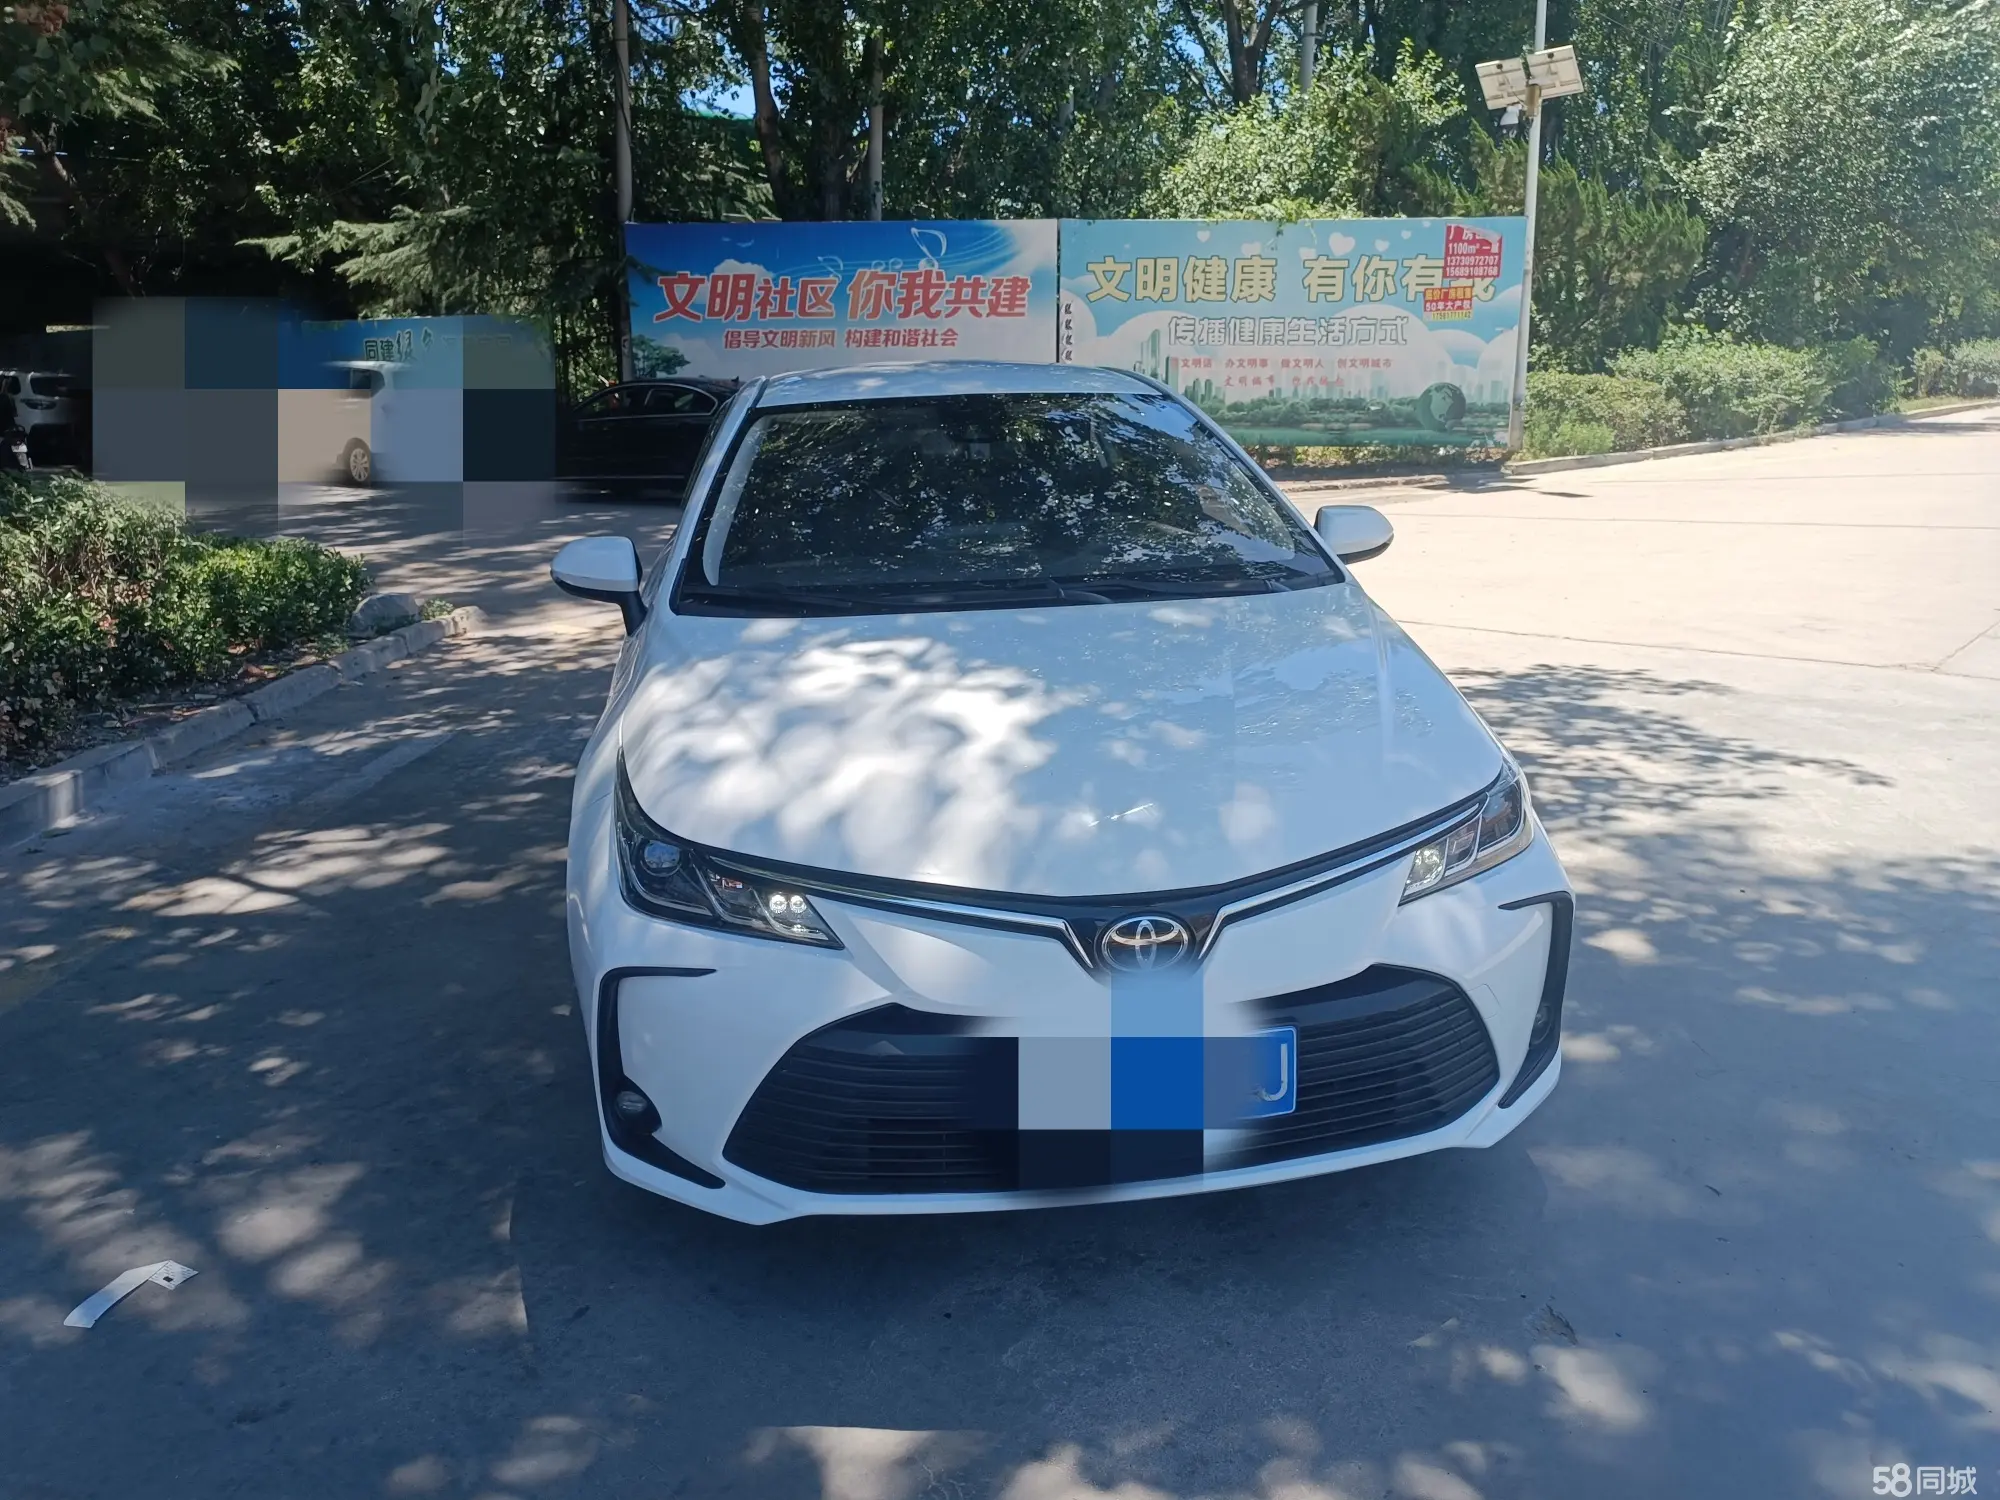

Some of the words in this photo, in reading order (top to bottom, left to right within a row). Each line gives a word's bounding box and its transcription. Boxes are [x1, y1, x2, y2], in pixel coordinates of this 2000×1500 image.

[1446, 256, 1498, 267] 13730972707
[1086, 255, 1278, 303] 文明健康
[654, 271, 839, 323] 文明社区
[847, 268, 1031, 322] 你我共建
[724, 329, 836, 349] 倡导文明新风
[844, 328, 959, 348] 构建和谐社会
[1167, 315, 1409, 347] 传播健康生活方式
